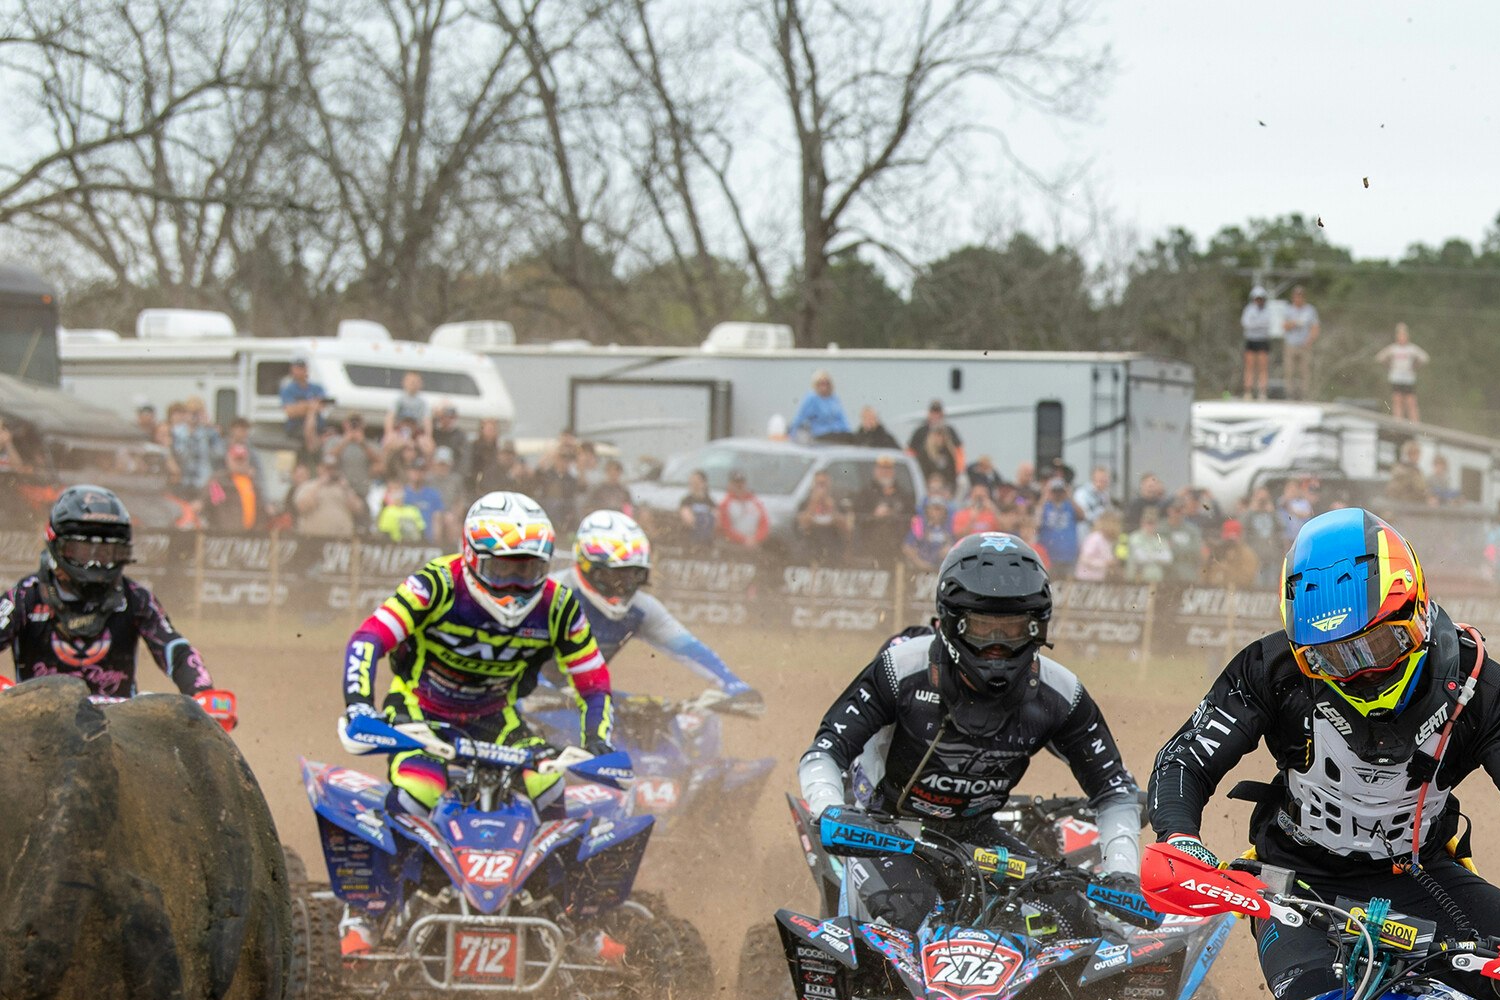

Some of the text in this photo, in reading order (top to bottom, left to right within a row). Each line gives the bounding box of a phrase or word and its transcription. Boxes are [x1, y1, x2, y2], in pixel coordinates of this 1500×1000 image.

[1316, 701, 1353, 736] LEATT
[1414, 702, 1449, 746] LEATT
[466, 854, 514, 879] 712
[1179, 878, 1261, 912] ACERBIS
[459, 935, 511, 974] 712
[931, 955, 1005, 986] 703
